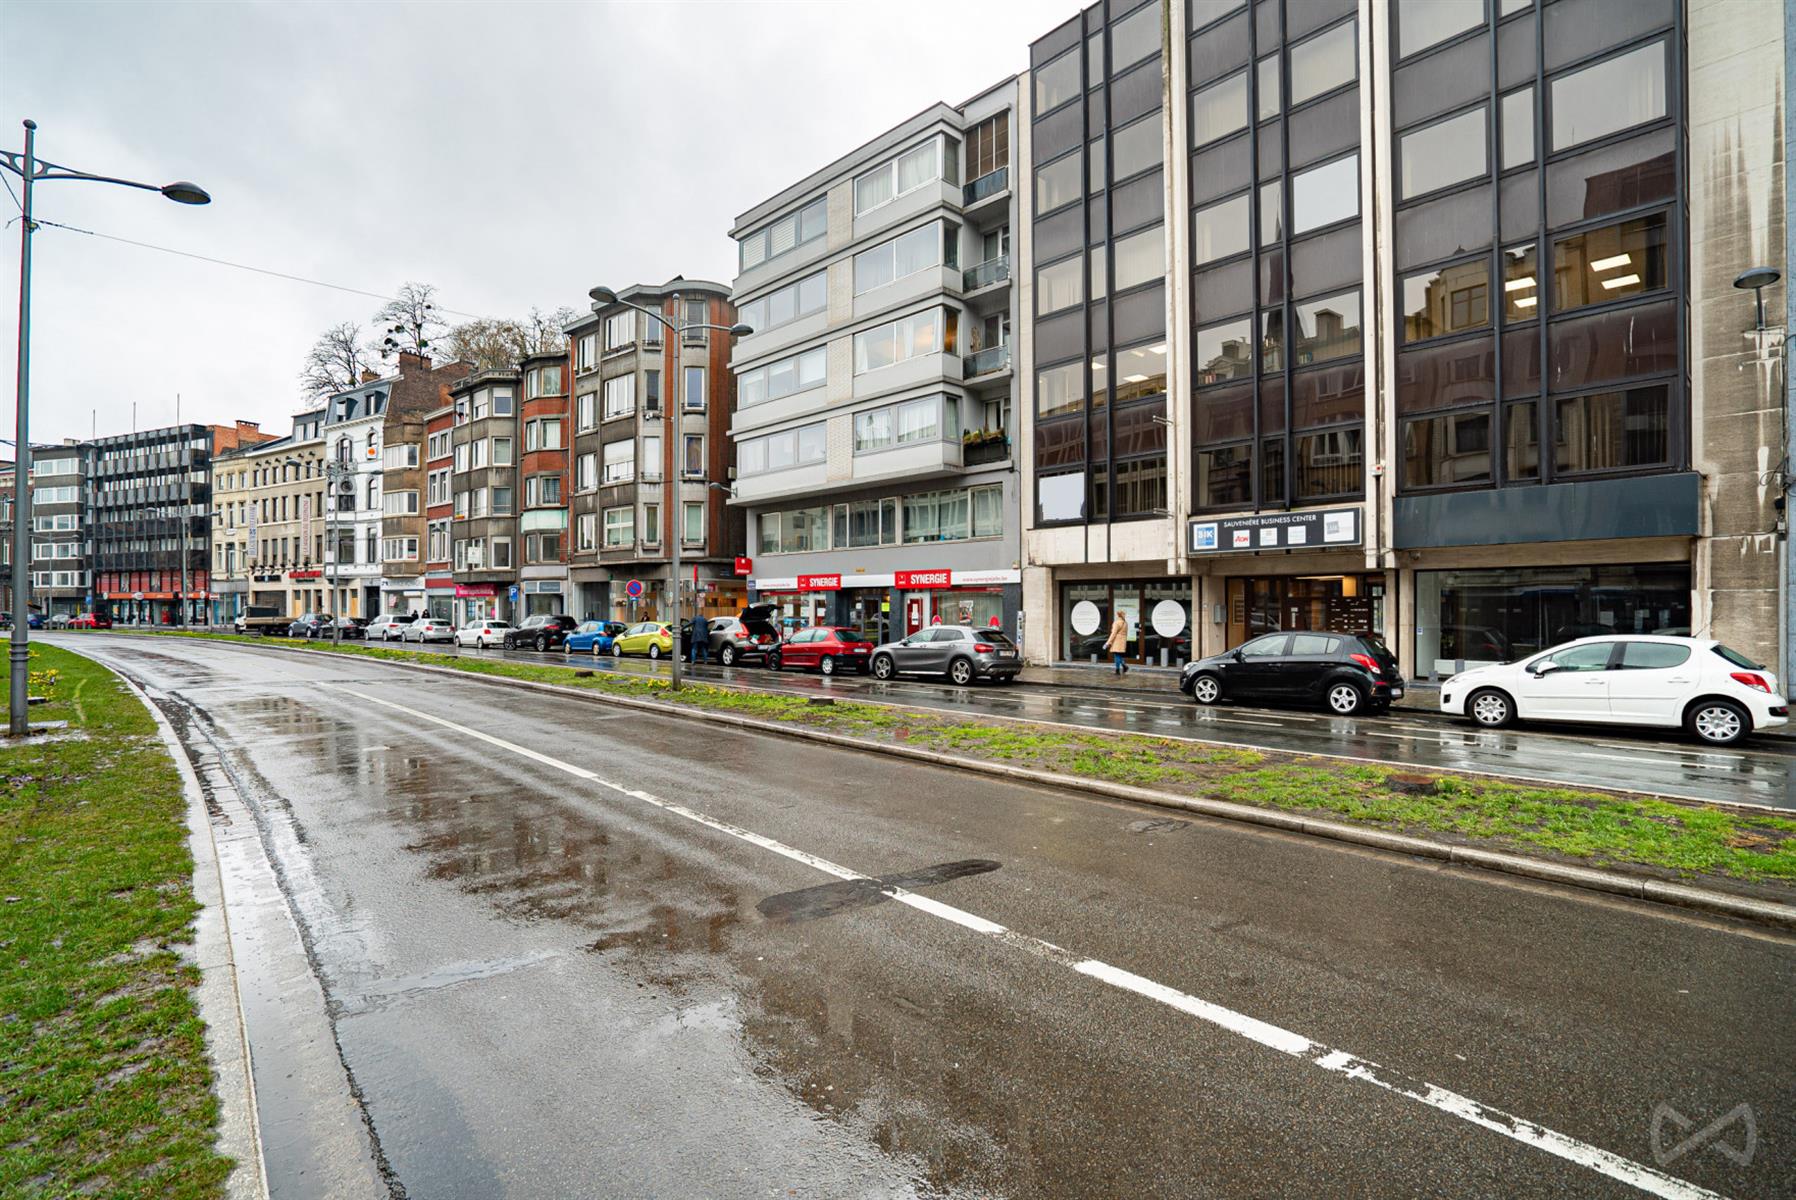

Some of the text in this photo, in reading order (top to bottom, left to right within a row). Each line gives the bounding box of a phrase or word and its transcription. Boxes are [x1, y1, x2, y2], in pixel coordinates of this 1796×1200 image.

[1261, 516, 1291, 525] BUSINESS
[1291, 514, 1317, 523] CENTER
[809, 577, 838, 588] SYNERGIE
[910, 573, 948, 585] SYNERGIE
[510, 587, 517, 597] P
